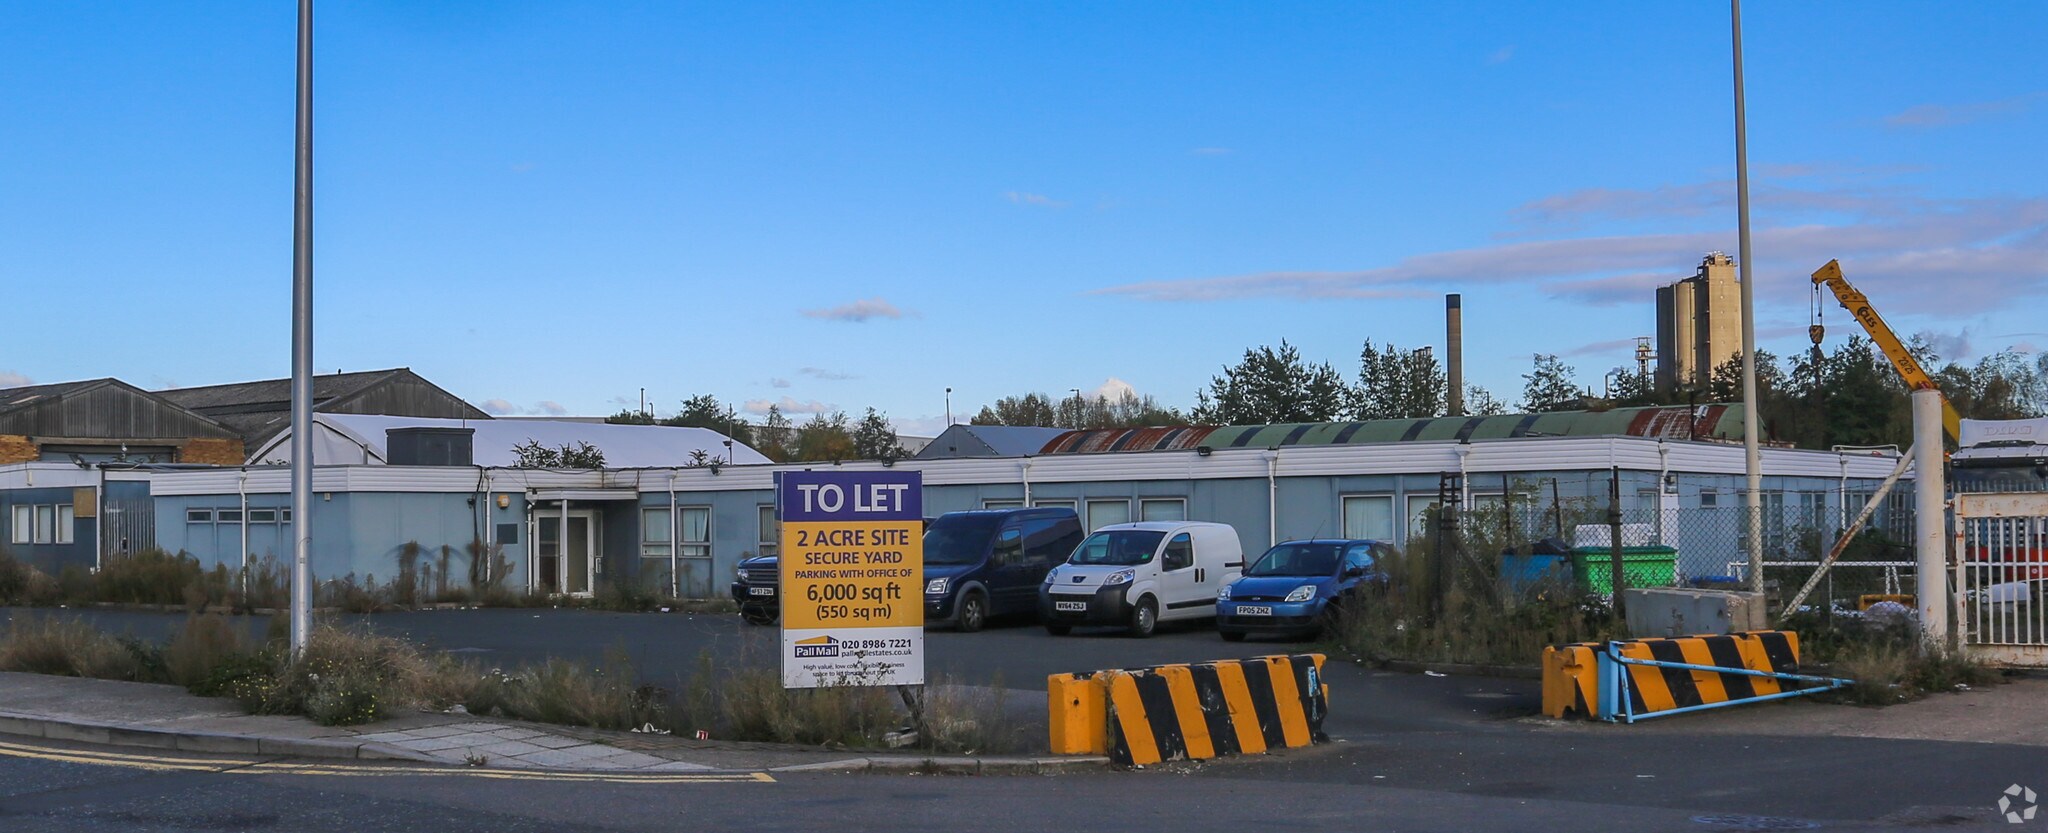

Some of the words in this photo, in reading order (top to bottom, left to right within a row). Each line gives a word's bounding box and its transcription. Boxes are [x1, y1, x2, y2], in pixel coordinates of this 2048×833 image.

[797, 484, 844, 513] TO
[854, 484, 909, 512] LET
[797, 530, 808, 547] 2
[814, 529, 865, 547] ACRE
[871, 529, 909, 546] SITE
[805, 552, 859, 565] SECURE
[864, 551, 903, 564] YARD
[795, 570, 836, 579] PARKING
[839, 569, 864, 578] WITH
[867, 568, 898, 578] OFFICE
[900, 568, 913, 577] OF
[807, 583, 857, 603] 6,000
[862, 587, 882, 604] sq
[886, 582, 901, 600] ft
[816, 604, 848, 620] (550
[853, 607, 870, 621] sq
[873, 603, 892, 619] m)
[1239, 606, 1255, 614] FP05
[842, 640, 860, 649] 020
[862, 639, 886, 649] 8986
[889, 638, 912, 648] 7221
[796, 647, 814, 657] Pall
[816, 646, 837, 656] Mall
